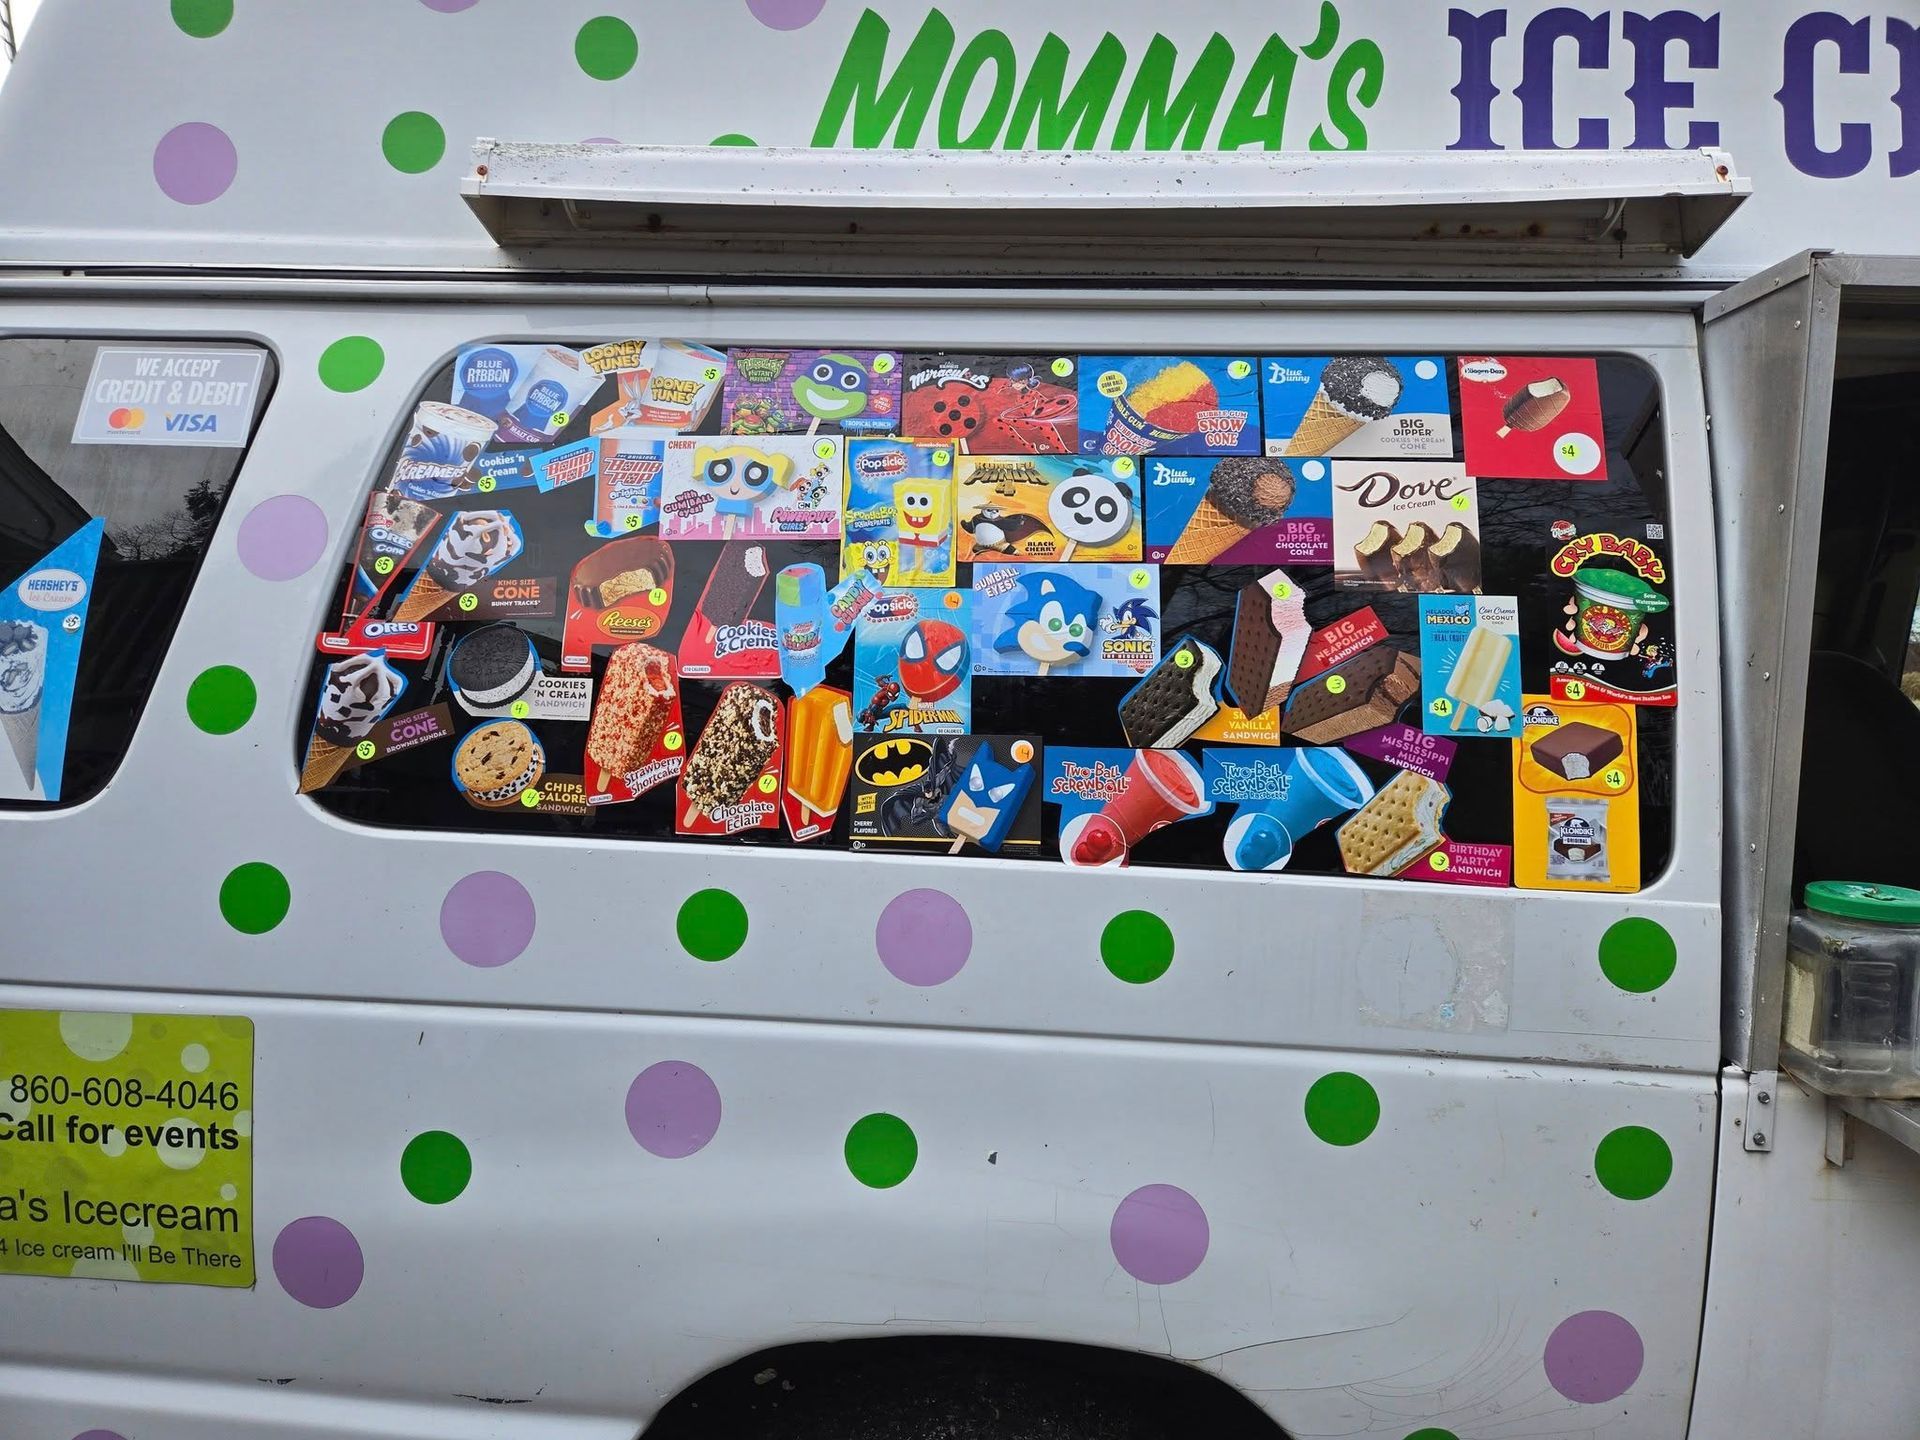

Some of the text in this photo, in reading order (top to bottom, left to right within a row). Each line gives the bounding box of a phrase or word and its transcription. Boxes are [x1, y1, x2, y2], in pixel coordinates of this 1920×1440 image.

[810, 1, 1385, 150] MOMMA'S
[1445, 7, 1720, 150] ICE
[583, 340, 647, 365] LOONEY
[135, 358, 220, 377] WE ACCEPT
[477, 360, 503, 368] BLUE
[591, 354, 641, 373] TUNES
[467, 369, 510, 383] RIBBON
[705, 369, 716, 380] $5
[651, 376, 705, 393] LOONEY
[95, 379, 248, 406] CREDIT & DEBIT
[541, 386, 560, 400] BLUE
[651, 389, 694, 405] TUNES
[529, 389, 562, 412] RIBBON
[553, 413, 565, 425] $5
[1197, 410, 1249, 419] BUBBLE GUM
[165, 413, 217, 432] VISA
[845, 420, 892, 428] TROPICAL PUNCH
[1128, 415, 1145, 430] GUM
[1198, 418, 1246, 433] SNOW
[1400, 419, 1424, 428] BIG
[510, 425, 527, 438] MALT
[668, 441, 697, 450] CHERRY
[1205, 432, 1239, 446] CONE
[1561, 445, 1575, 457] $4
[479, 456, 514, 468] Cookies
[862, 456, 904, 469] Popsicle
[975, 462, 1008, 470] KUNG
[487, 467, 518, 477] Cream
[963, 468, 1050, 485] PANDA
[479, 478, 492, 489] $5
[995, 480, 1015, 496] 4
[1336, 472, 1472, 508] Dove
[676, 490, 699, 501] with
[663, 503, 688, 514] GUM
[688, 494, 714, 507] BALL
[678, 504, 703, 518] eyes!
[1393, 500, 1436, 511] Ice Cream
[625, 516, 638, 528] $5
[770, 508, 837, 523] POWERPUFF
[780, 523, 805, 532] GIRLS
[1287, 523, 1315, 534] BIG
[371, 528, 414, 549] OREO
[1278, 534, 1321, 542] DIPPER
[375, 544, 405, 556] Cone
[1553, 535, 1663, 578] CRY BABY
[377, 559, 389, 571] $5
[28, 579, 80, 592] HERSHEY'S
[974, 567, 1020, 592] GUMBALL
[493, 587, 540, 599] CONE
[986, 580, 1017, 598] EYES!
[29, 593, 74, 602] Ice Cream
[461, 596, 473, 608] $5
[831, 579, 864, 618] CANDY
[66, 616, 78, 628] $5
[602, 611, 653, 628] Reese's
[1427, 615, 1471, 625] MEXICO
[364, 622, 419, 637] OREO
[716, 625, 777, 643] Cookies
[1323, 621, 1357, 645] BIG
[716, 641, 728, 657] &
[728, 637, 779, 651] Creme
[1103, 640, 1153, 653] SONIC
[1315, 622, 1377, 662] NEAPOLITAN
[1328, 635, 1374, 665] SANDWICH
[538, 680, 586, 689] COOKIES
[1567, 683, 1580, 697] $4
[549, 691, 587, 700] CREAM
[534, 700, 586, 708] SANDWICH
[1433, 700, 1448, 712] $4
[393, 711, 429, 728] KING SIZE
[884, 708, 964, 733] SPIDER-MAN
[1229, 720, 1272, 730] VANILLA
[1523, 716, 1559, 726] KLONDIKE
[390, 721, 440, 743] CONE
[1223, 731, 1278, 740] SANDWICH
[1403, 728, 1436, 749] BIG
[386, 730, 447, 754] BROWNIE SUNDAE
[359, 743, 372, 756] $5
[1382, 735, 1449, 766] MISSISSIPPI
[1398, 752, 1424, 765] MUD
[624, 756, 684, 787] Strawberry
[1062, 761, 1121, 778] Two-Ball
[1220, 761, 1281, 779] Two-Ball
[1383, 754, 1435, 778] SANDWICH
[630, 766, 681, 797] Shortcake
[1051, 776, 1129, 793] Screwball
[1211, 776, 1291, 794] Screwball
[1606, 772, 1621, 785] $4
[544, 782, 583, 794] CHIPS
[537, 791, 586, 804] GALORE
[1080, 790, 1114, 802] Cherry
[1230, 790, 1288, 801] Blue Raspberry
[536, 803, 587, 814] SANDWICH
[711, 800, 774, 821] Chocolate
[726, 815, 761, 832] Eclair
[1560, 826, 1594, 837] KLONDIKE
[1450, 844, 1503, 857] BIRTHDAY
[1455, 856, 1492, 867] PARTY
[1445, 865, 1502, 878] SANDWICH
[10, 1074, 239, 1111] 860-608-4046
[66, 1116, 115, 1145] for
[124, 1121, 239, 1150] events
[63, 1190, 239, 1233] Icecream
[16, 1239, 45, 1257] Ice
[53, 1245, 115, 1261] cream
[123, 1244, 141, 1262] I'll
[150, 1246, 176, 1264] Be
[181, 1247, 242, 1269] There
